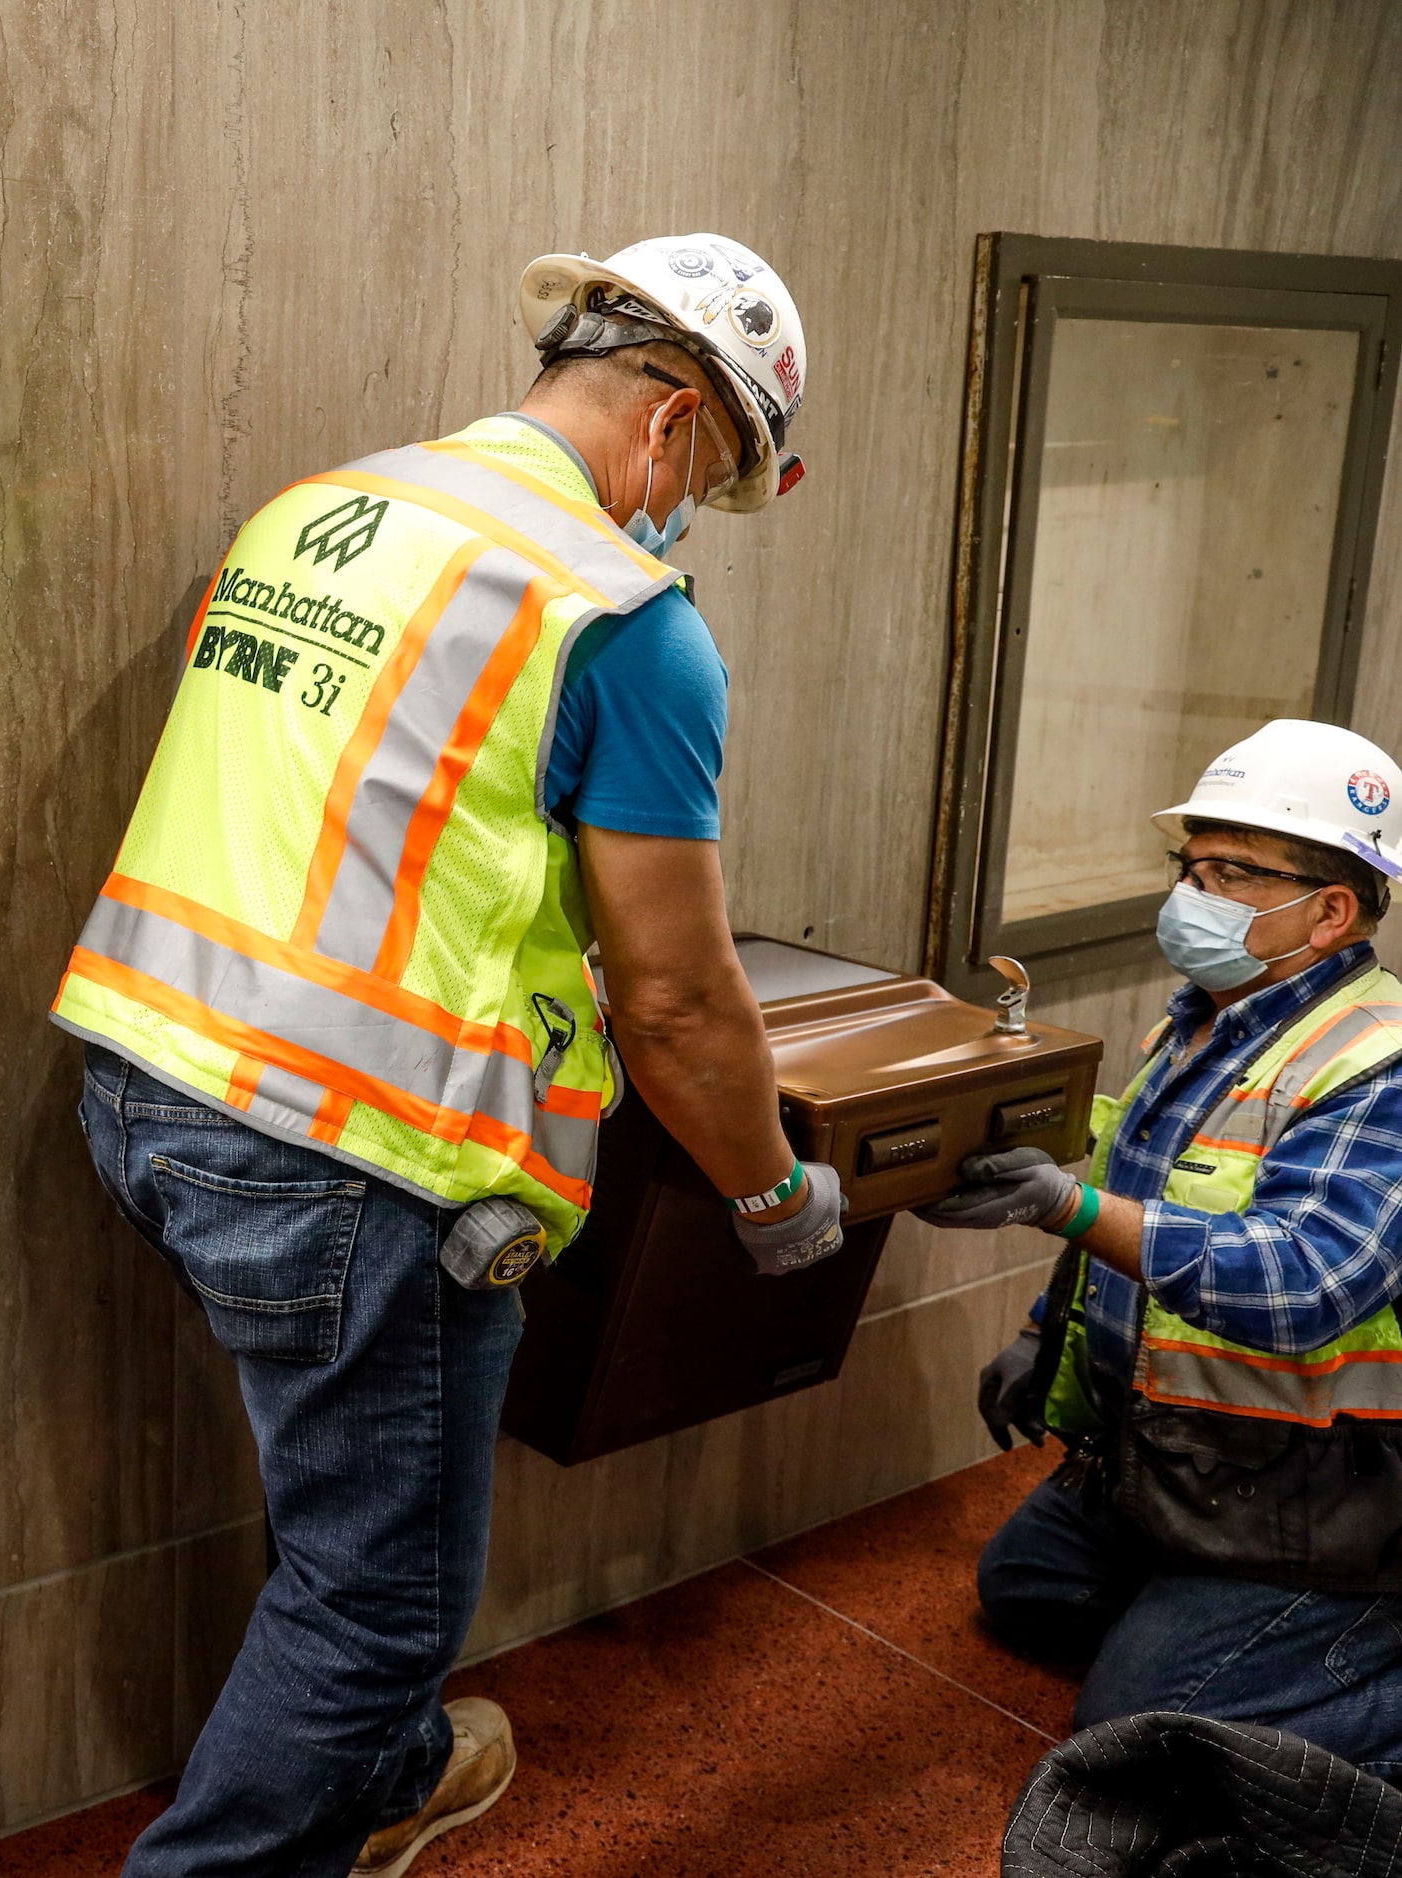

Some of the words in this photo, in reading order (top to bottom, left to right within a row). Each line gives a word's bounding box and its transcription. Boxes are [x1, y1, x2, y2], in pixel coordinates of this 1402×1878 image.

[781, 345, 801, 394] SUN
[212, 567, 386, 656] Manhattan
[193, 626, 299, 693] BYRNE
[300, 663, 346, 717] 3i
[1349, 789, 1387, 814] RANGERS
[1364, 781, 1379, 802] T
[1019, 1107, 1052, 1130] PUSH
[890, 1138, 926, 1161] PUSH
